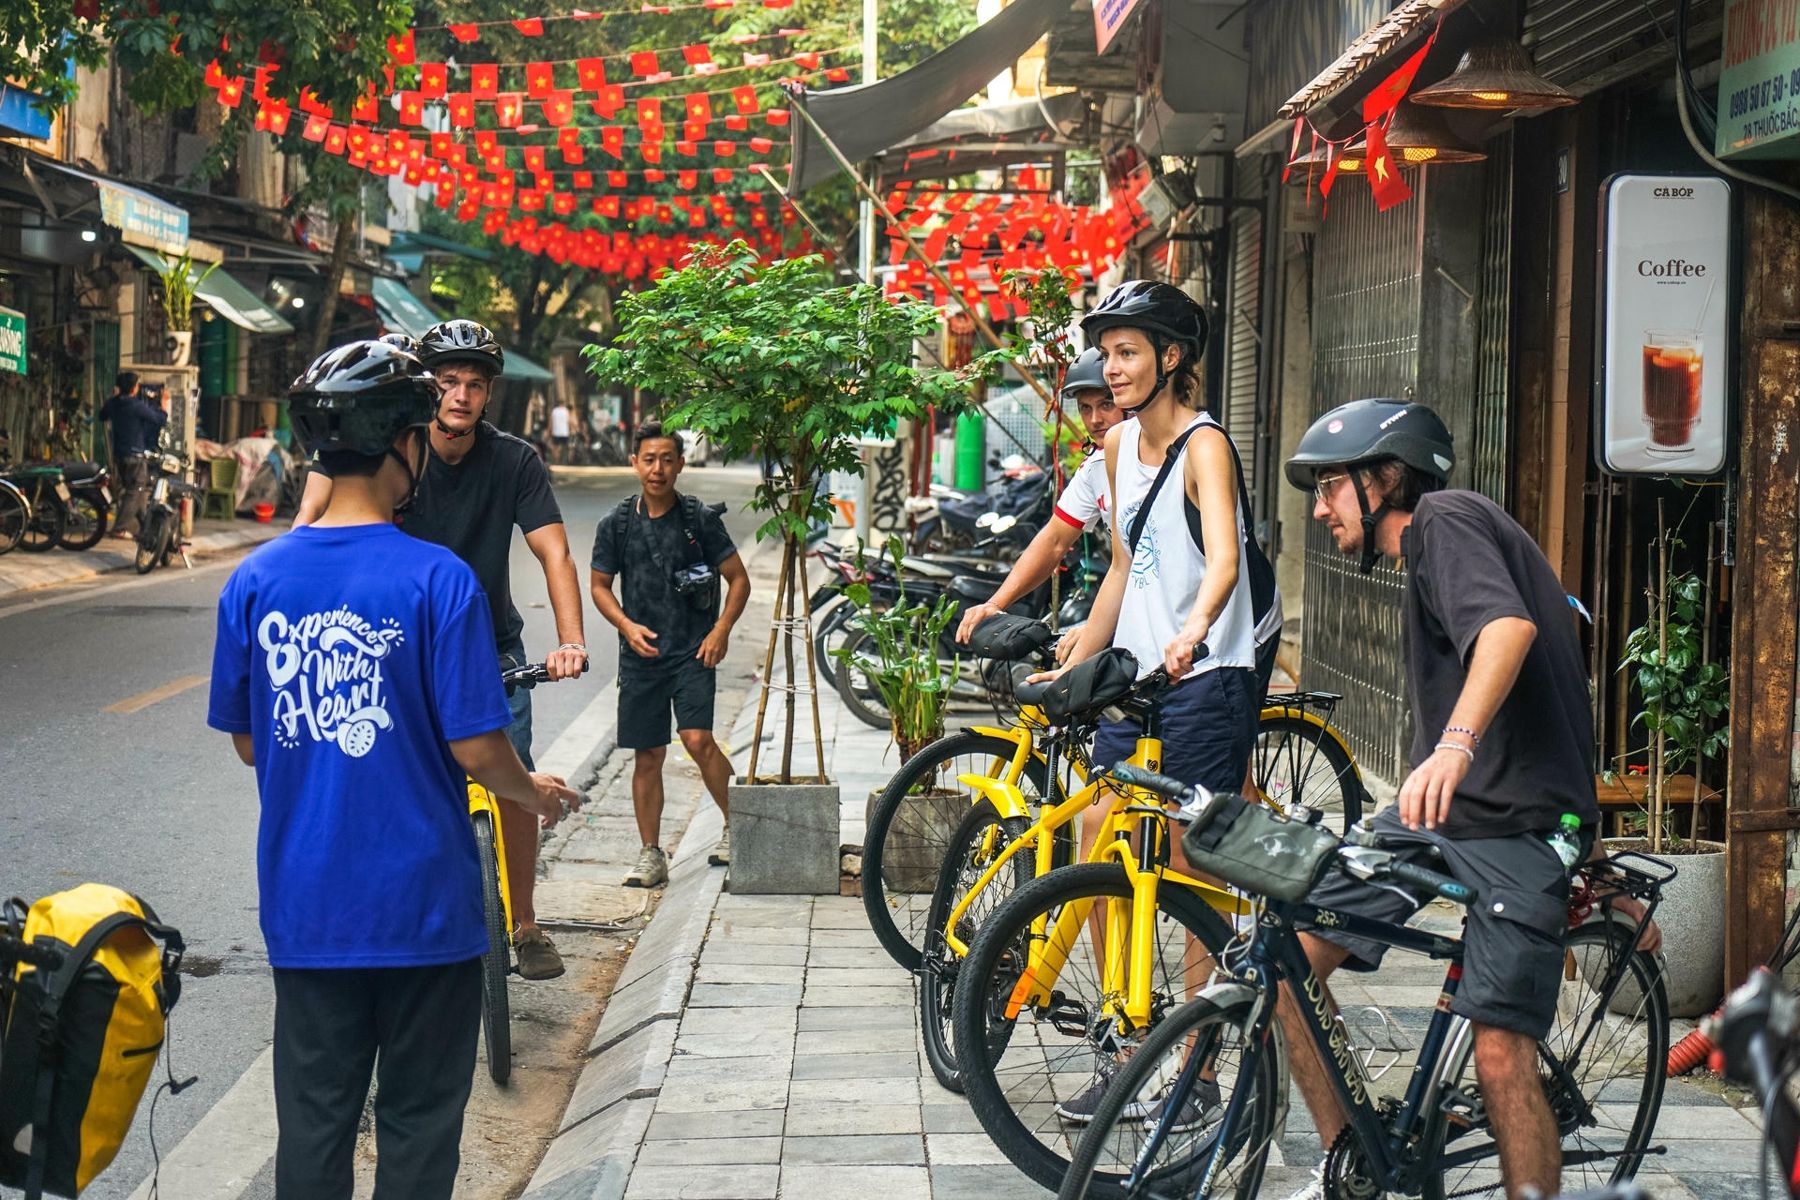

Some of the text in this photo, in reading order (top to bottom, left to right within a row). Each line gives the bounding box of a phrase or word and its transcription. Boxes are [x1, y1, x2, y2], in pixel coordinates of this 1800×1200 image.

[1773, 74, 1784, 104] 50
[1638, 259, 1706, 277] Coffee
[258, 603, 397, 691] Experiences
[302, 648, 373, 696] With
[273, 660, 390, 742] Heart
[1303, 970, 1367, 1105] LOUIS GARNEAU
